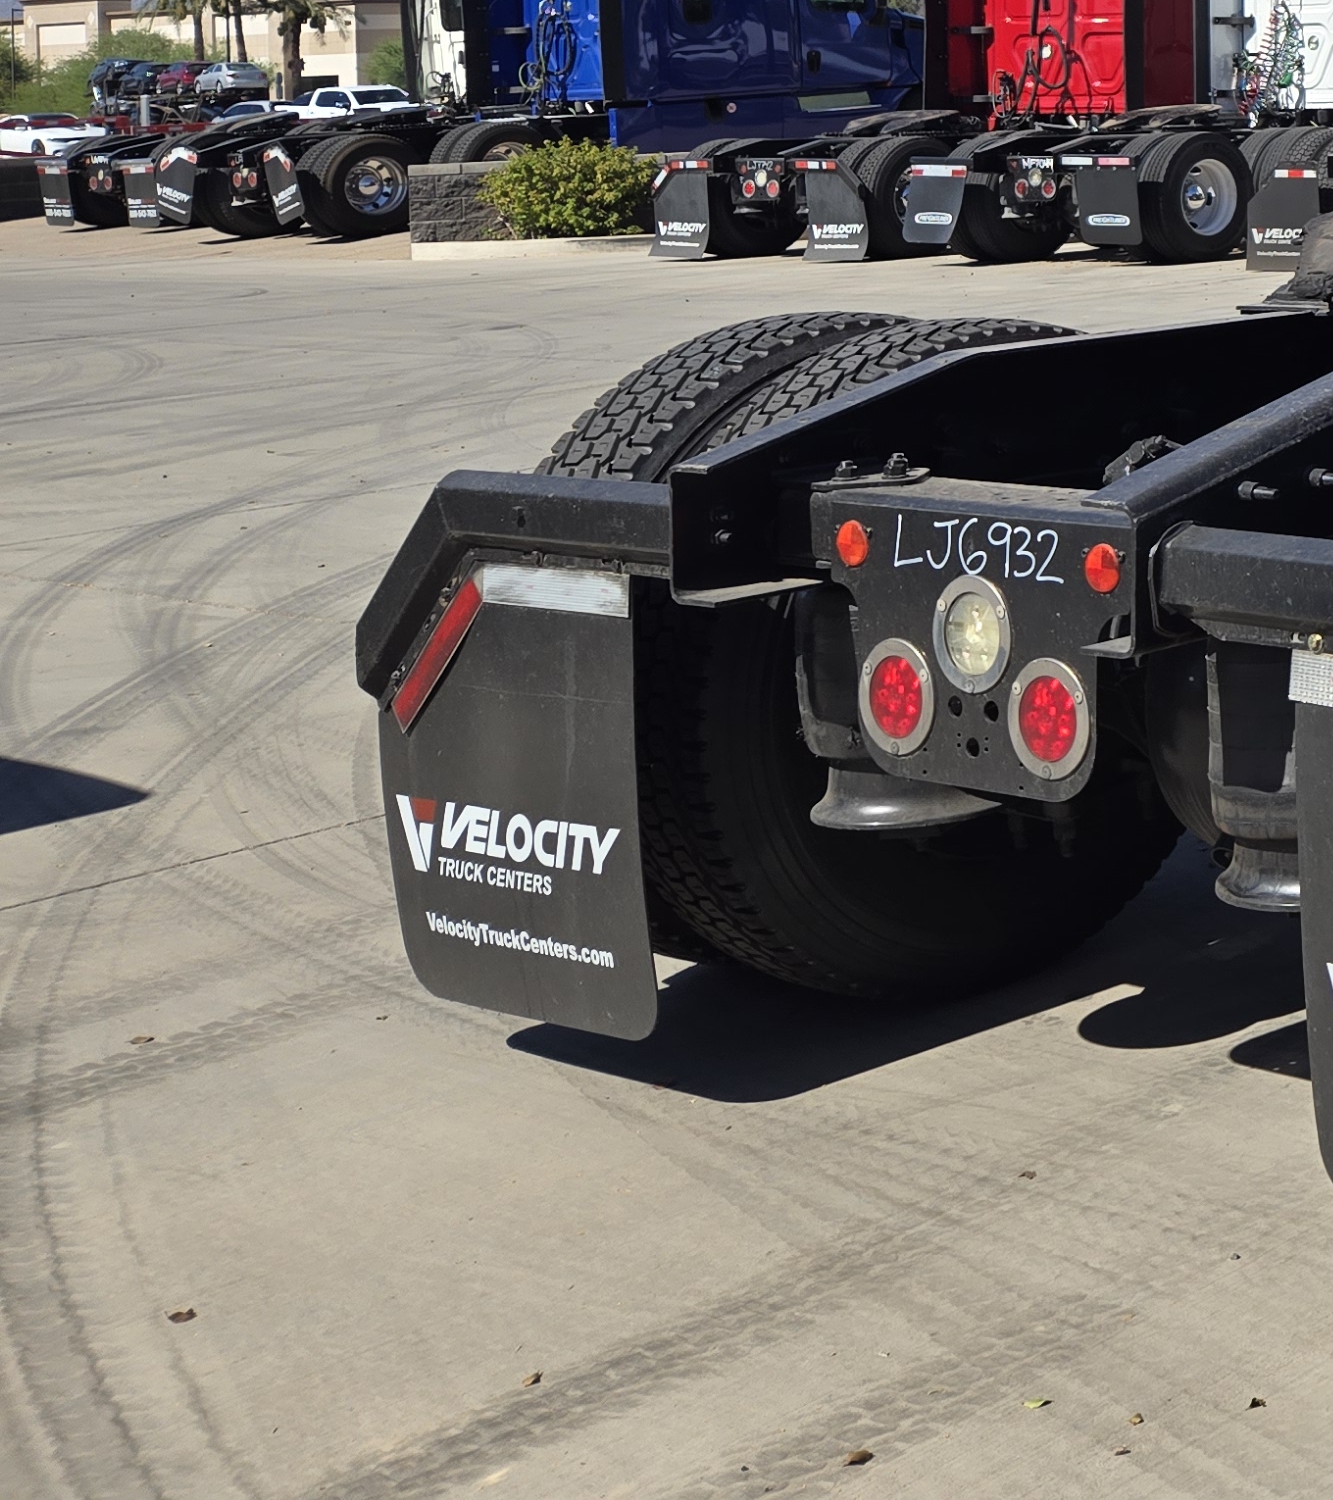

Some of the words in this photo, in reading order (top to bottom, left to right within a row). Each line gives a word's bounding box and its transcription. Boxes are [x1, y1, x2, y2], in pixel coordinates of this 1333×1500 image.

[668, 222, 707, 234] VELOCITY
[821, 223, 865, 234] VELOCITY
[1264, 227, 1303, 239] VELOC
[892, 513, 1065, 585] LJ6932
[439, 801, 621, 876] VELOCITY
[438, 856, 484, 888] TRUCK
[486, 864, 553, 897] CENTERS
[425, 911, 615, 969] VelocityTruckCenters.com
